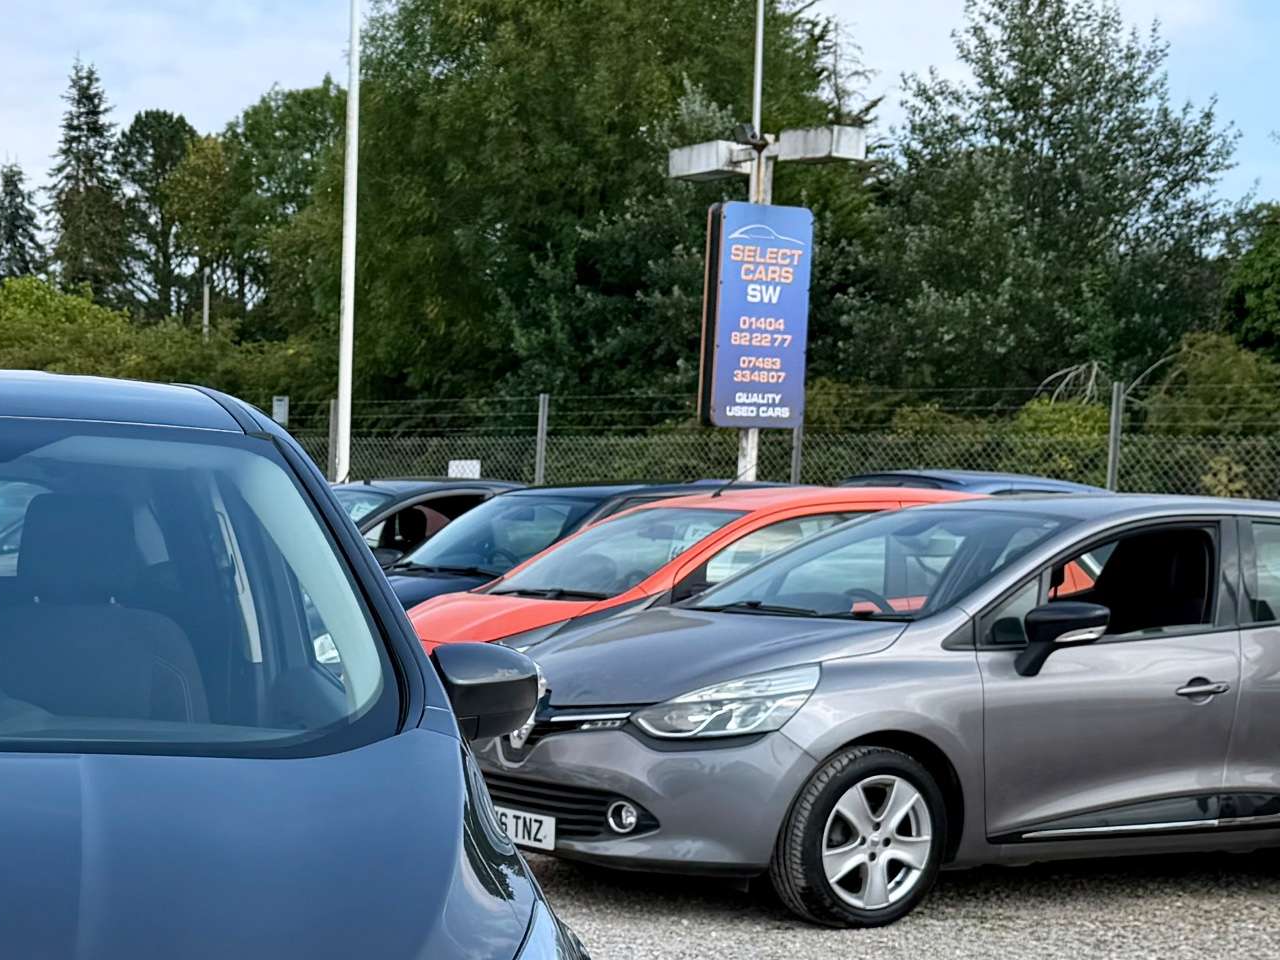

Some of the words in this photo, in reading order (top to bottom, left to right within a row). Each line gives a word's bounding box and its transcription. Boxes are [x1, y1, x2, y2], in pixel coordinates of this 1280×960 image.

[730, 244, 803, 265] SELECT
[740, 263, 794, 284] CARS
[746, 283, 781, 304] SW
[739, 316, 785, 331] 01404
[735, 392, 782, 404] QUALITY
[726, 406, 757, 417] USED
[759, 406, 790, 418] CARS
[513, 814, 544, 843] TNZ
